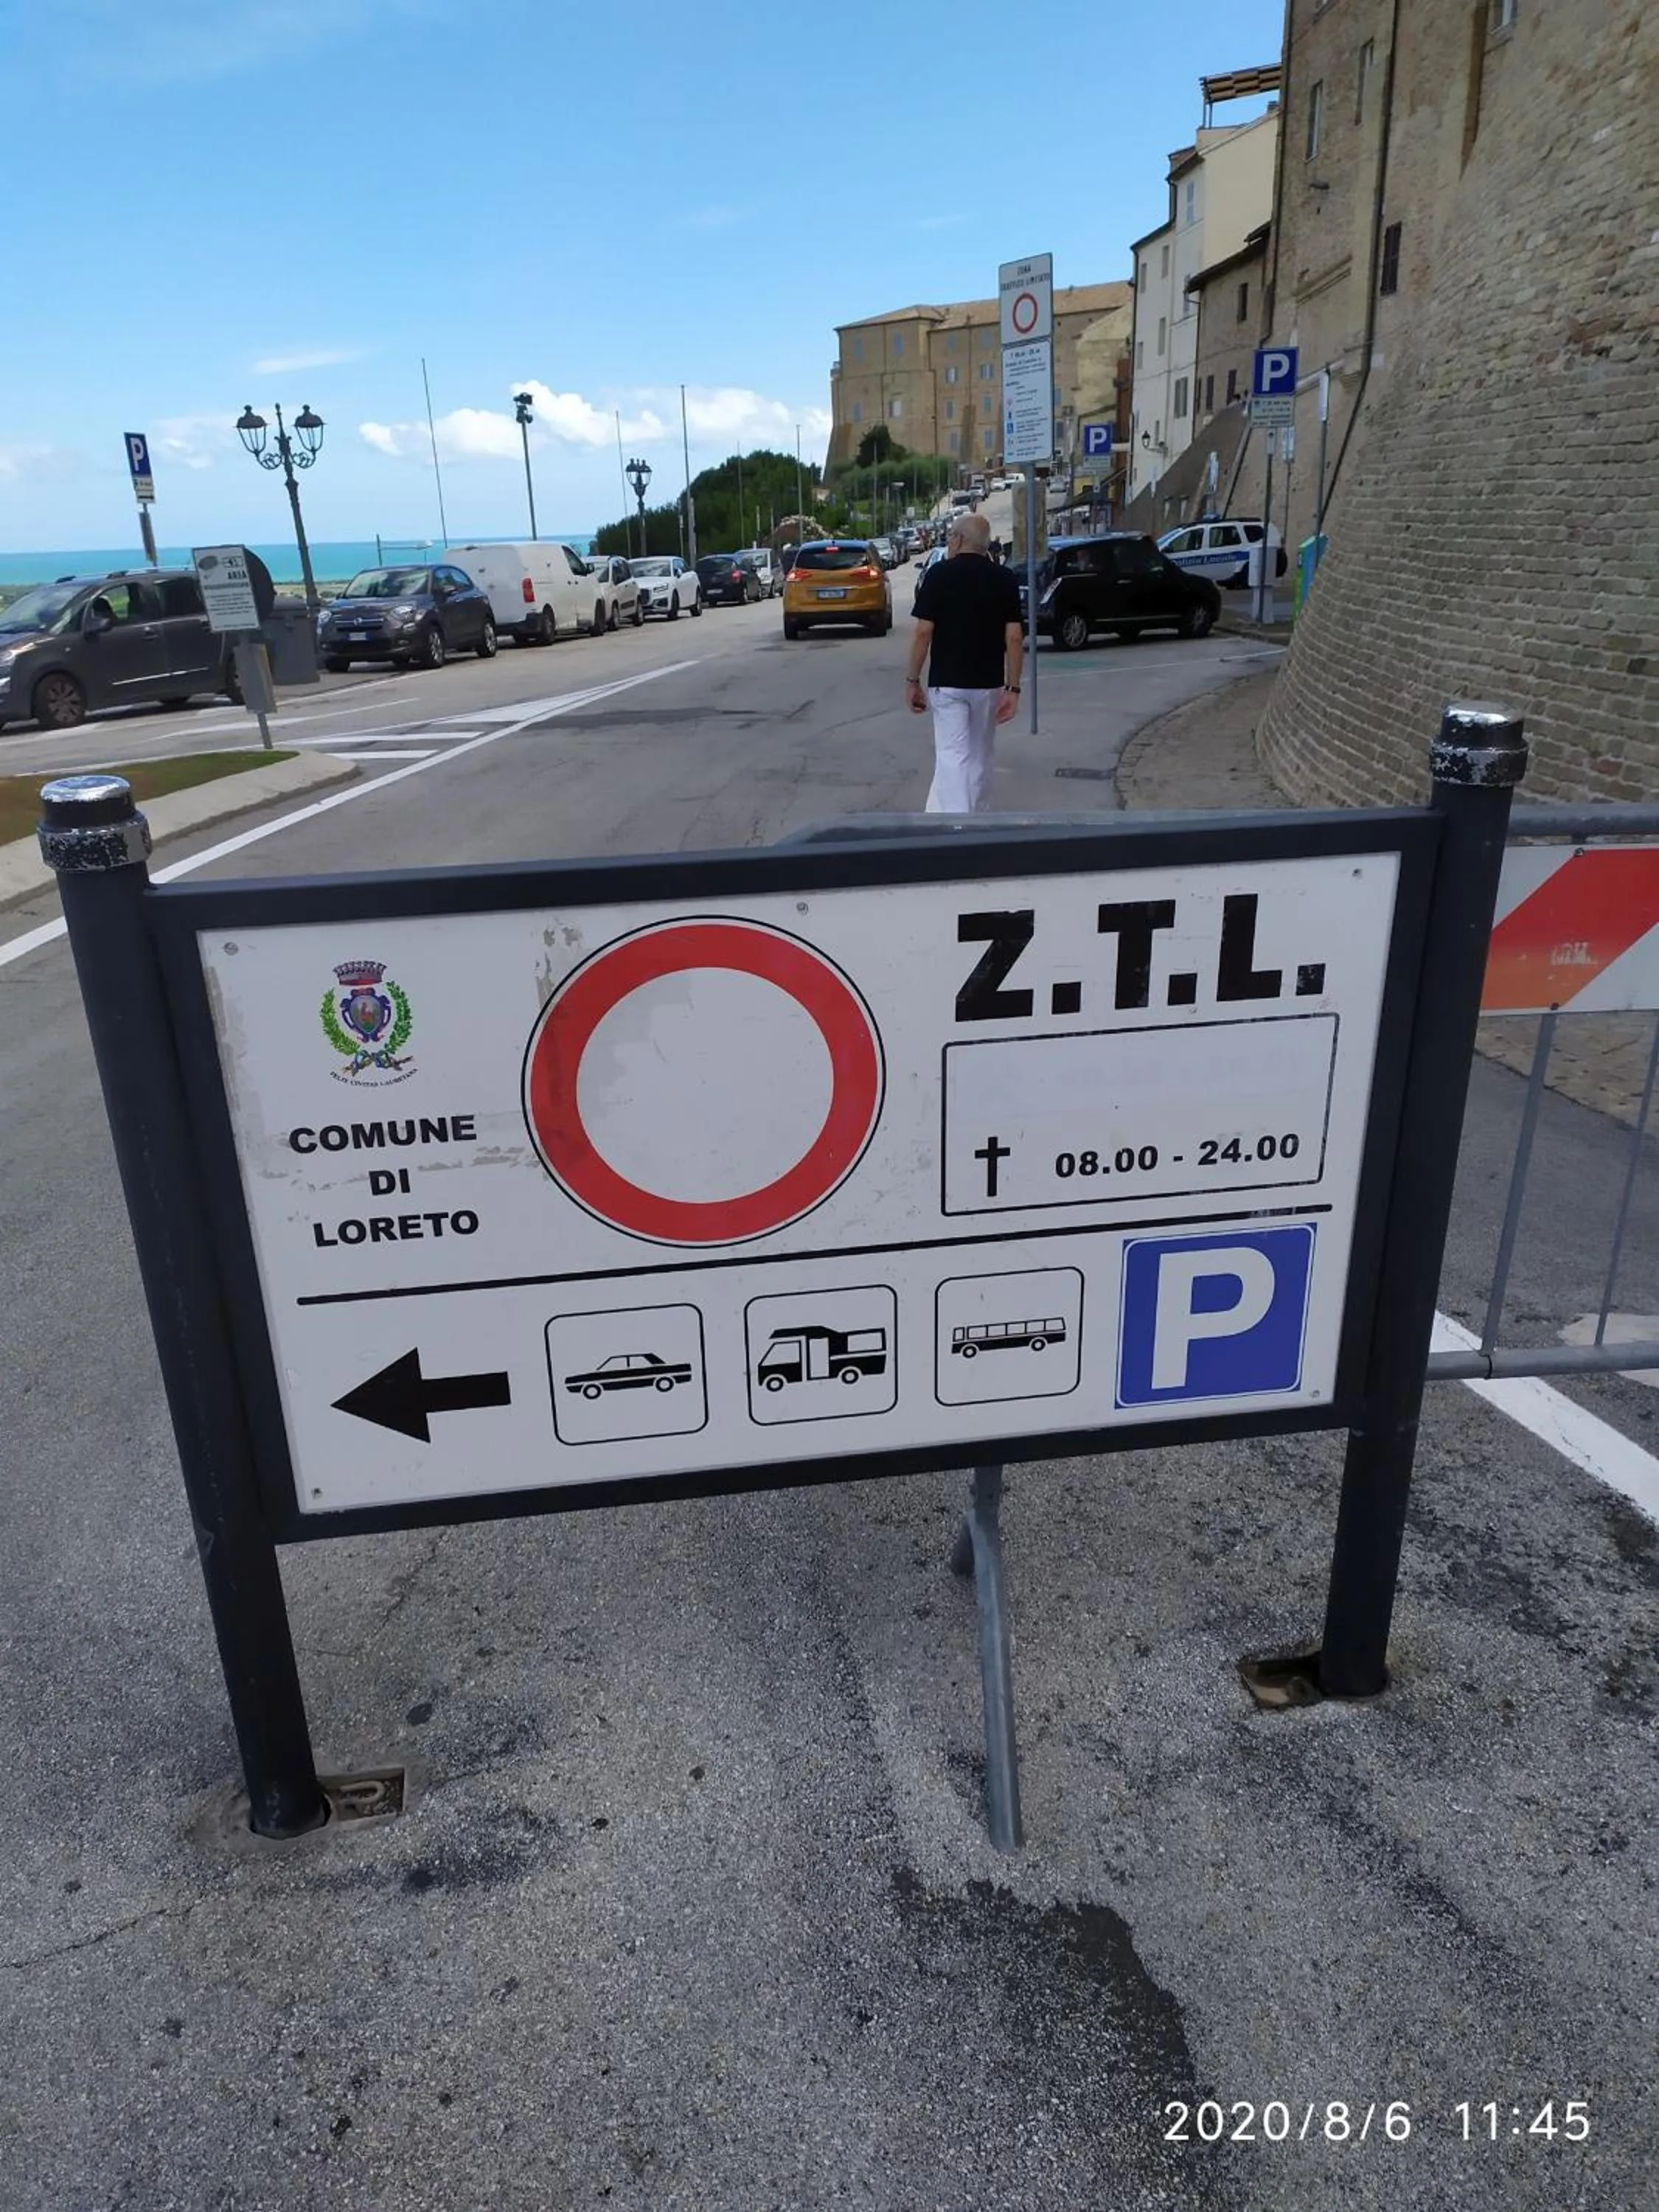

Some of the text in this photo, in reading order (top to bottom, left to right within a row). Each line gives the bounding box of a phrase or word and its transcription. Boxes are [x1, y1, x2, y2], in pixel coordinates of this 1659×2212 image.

[1262, 353, 1290, 392] P
[130, 437, 145, 471] P
[1089, 428, 1107, 452] P
[956, 894, 1326, 1022] Z.T.L.
[289, 1115, 476, 1153] COMUNE
[1056, 1146, 1158, 1178] 08.00
[1198, 1134, 1299, 1165] 24.00
[369, 1169, 411, 1195] DI
[313, 1210, 479, 1247] LORETO
[1152, 1247, 1275, 1389] P
